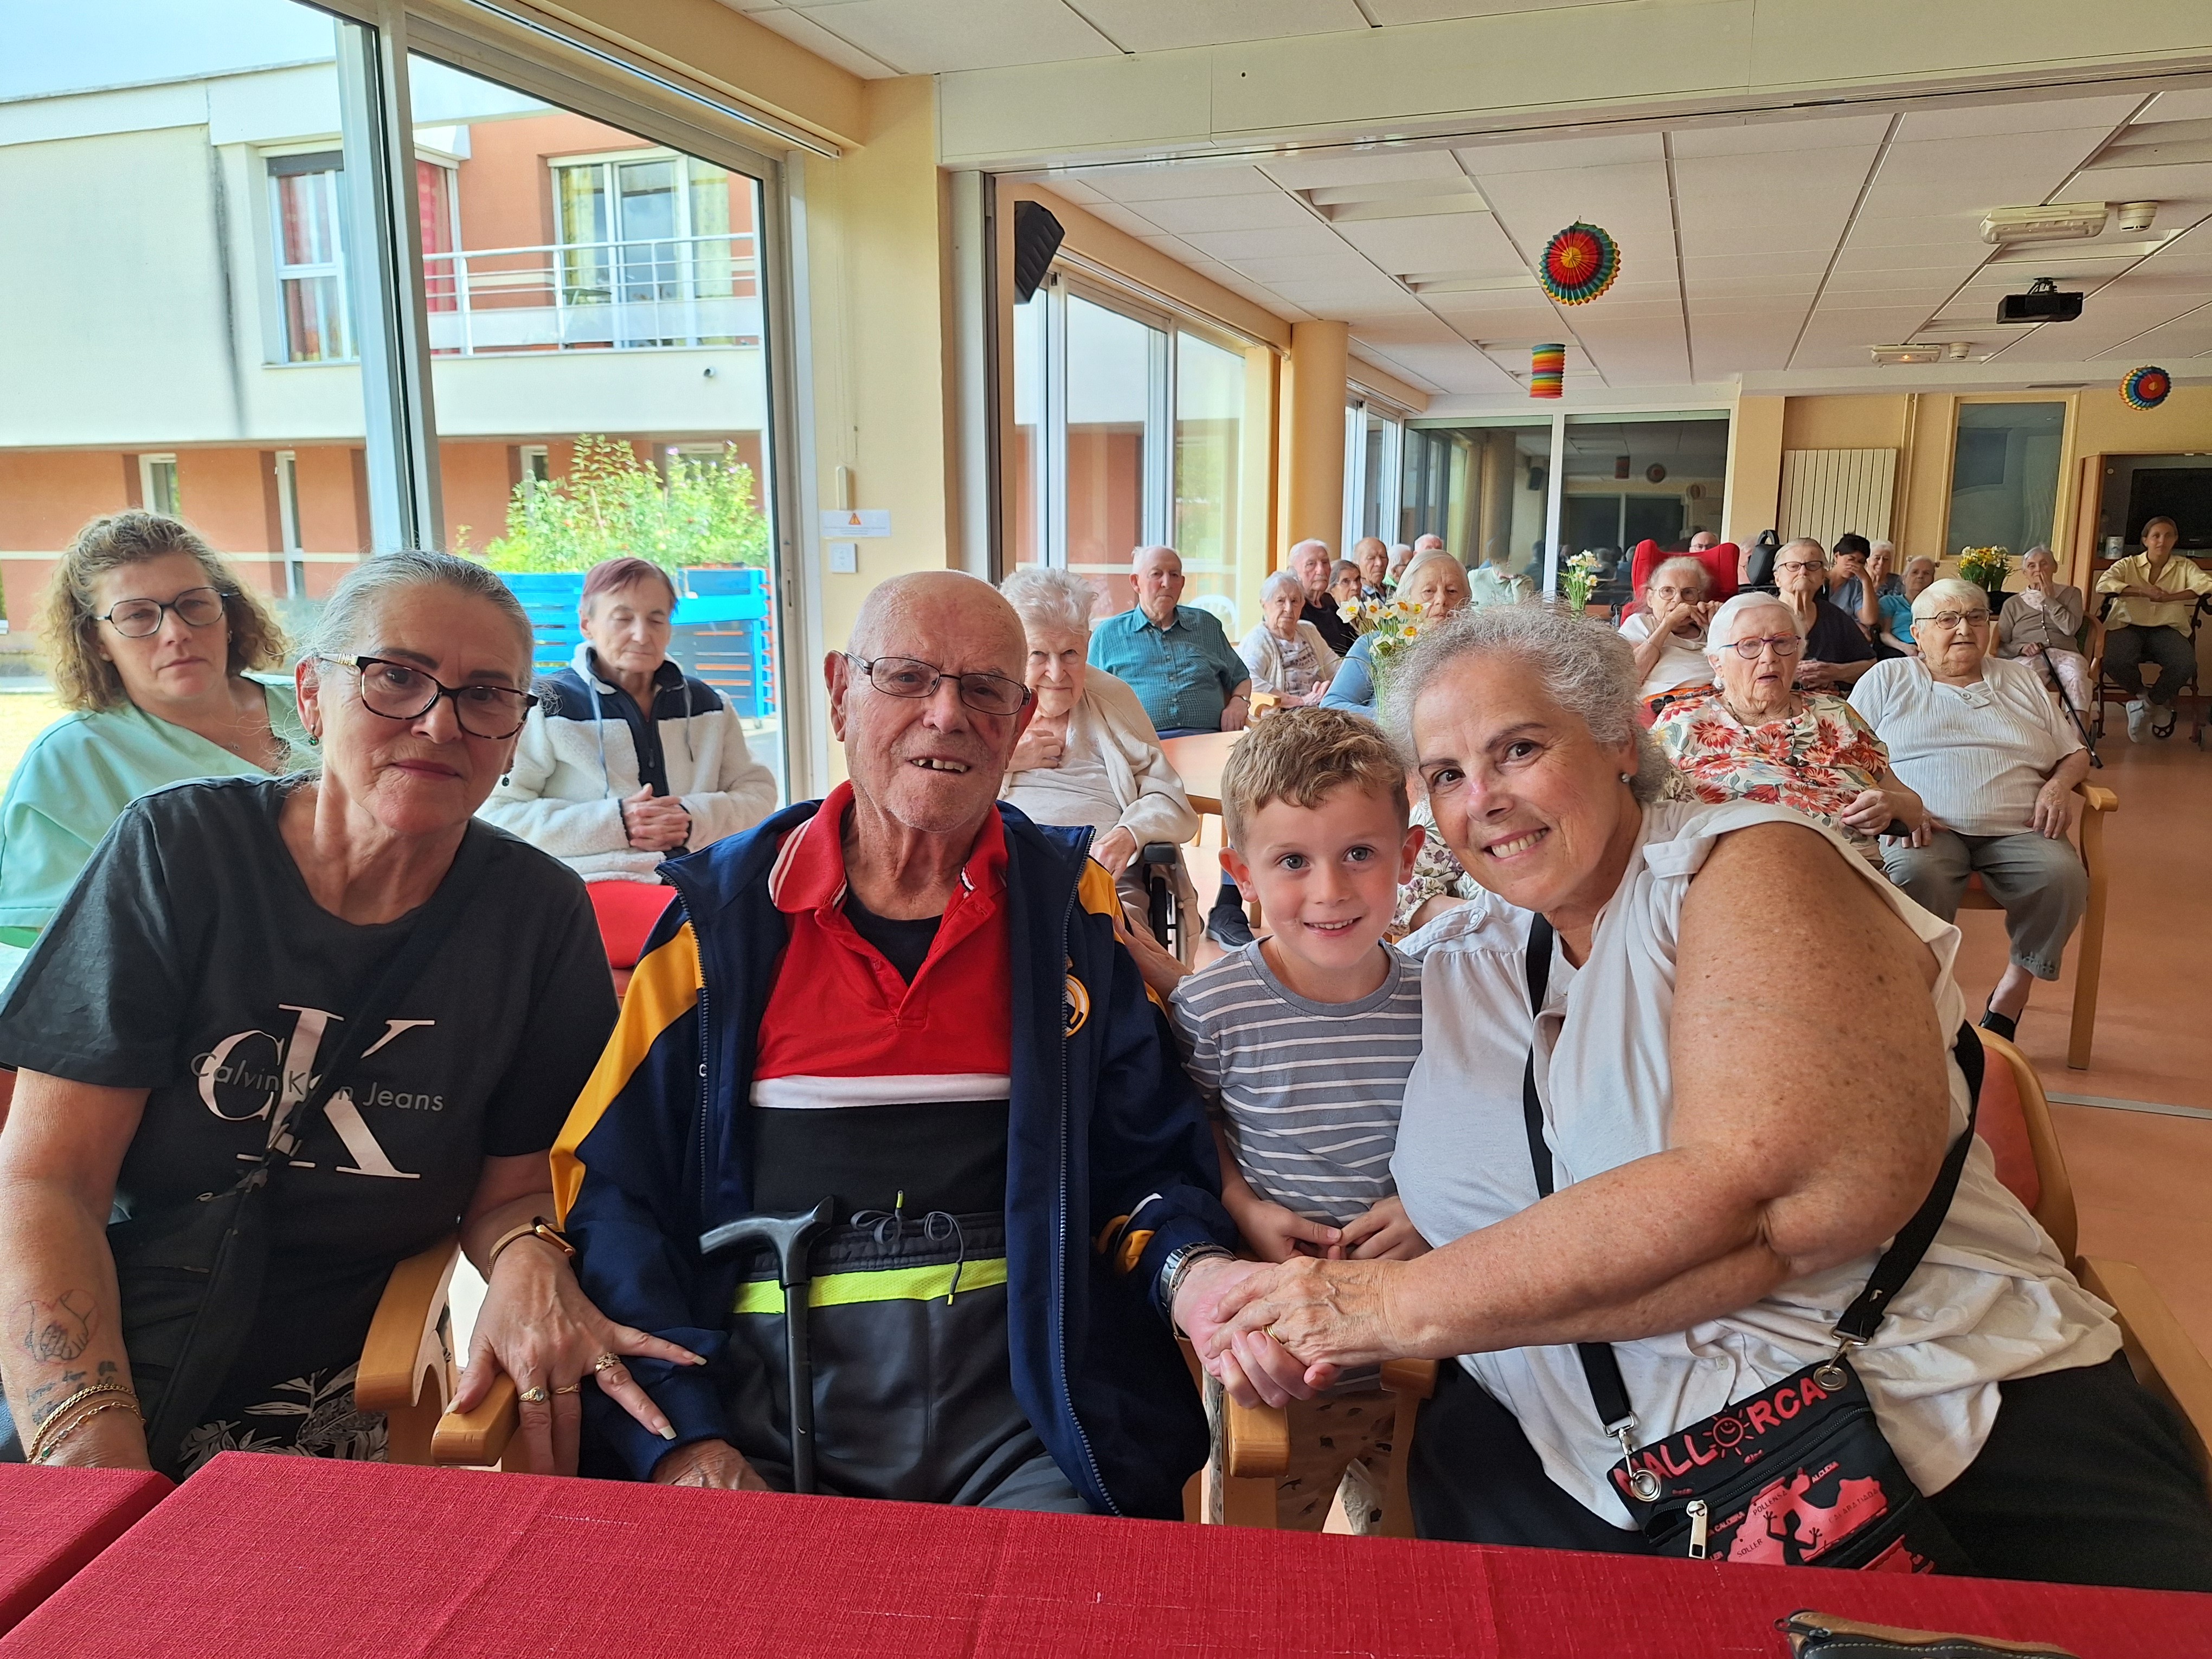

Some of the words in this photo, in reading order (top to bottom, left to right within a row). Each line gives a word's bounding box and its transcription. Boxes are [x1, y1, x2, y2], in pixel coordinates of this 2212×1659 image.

[190, 1052, 280, 1091] Calvin
[362, 1082, 444, 1111] Jeans
[1737, 1539, 1763, 1558] SOLLER
